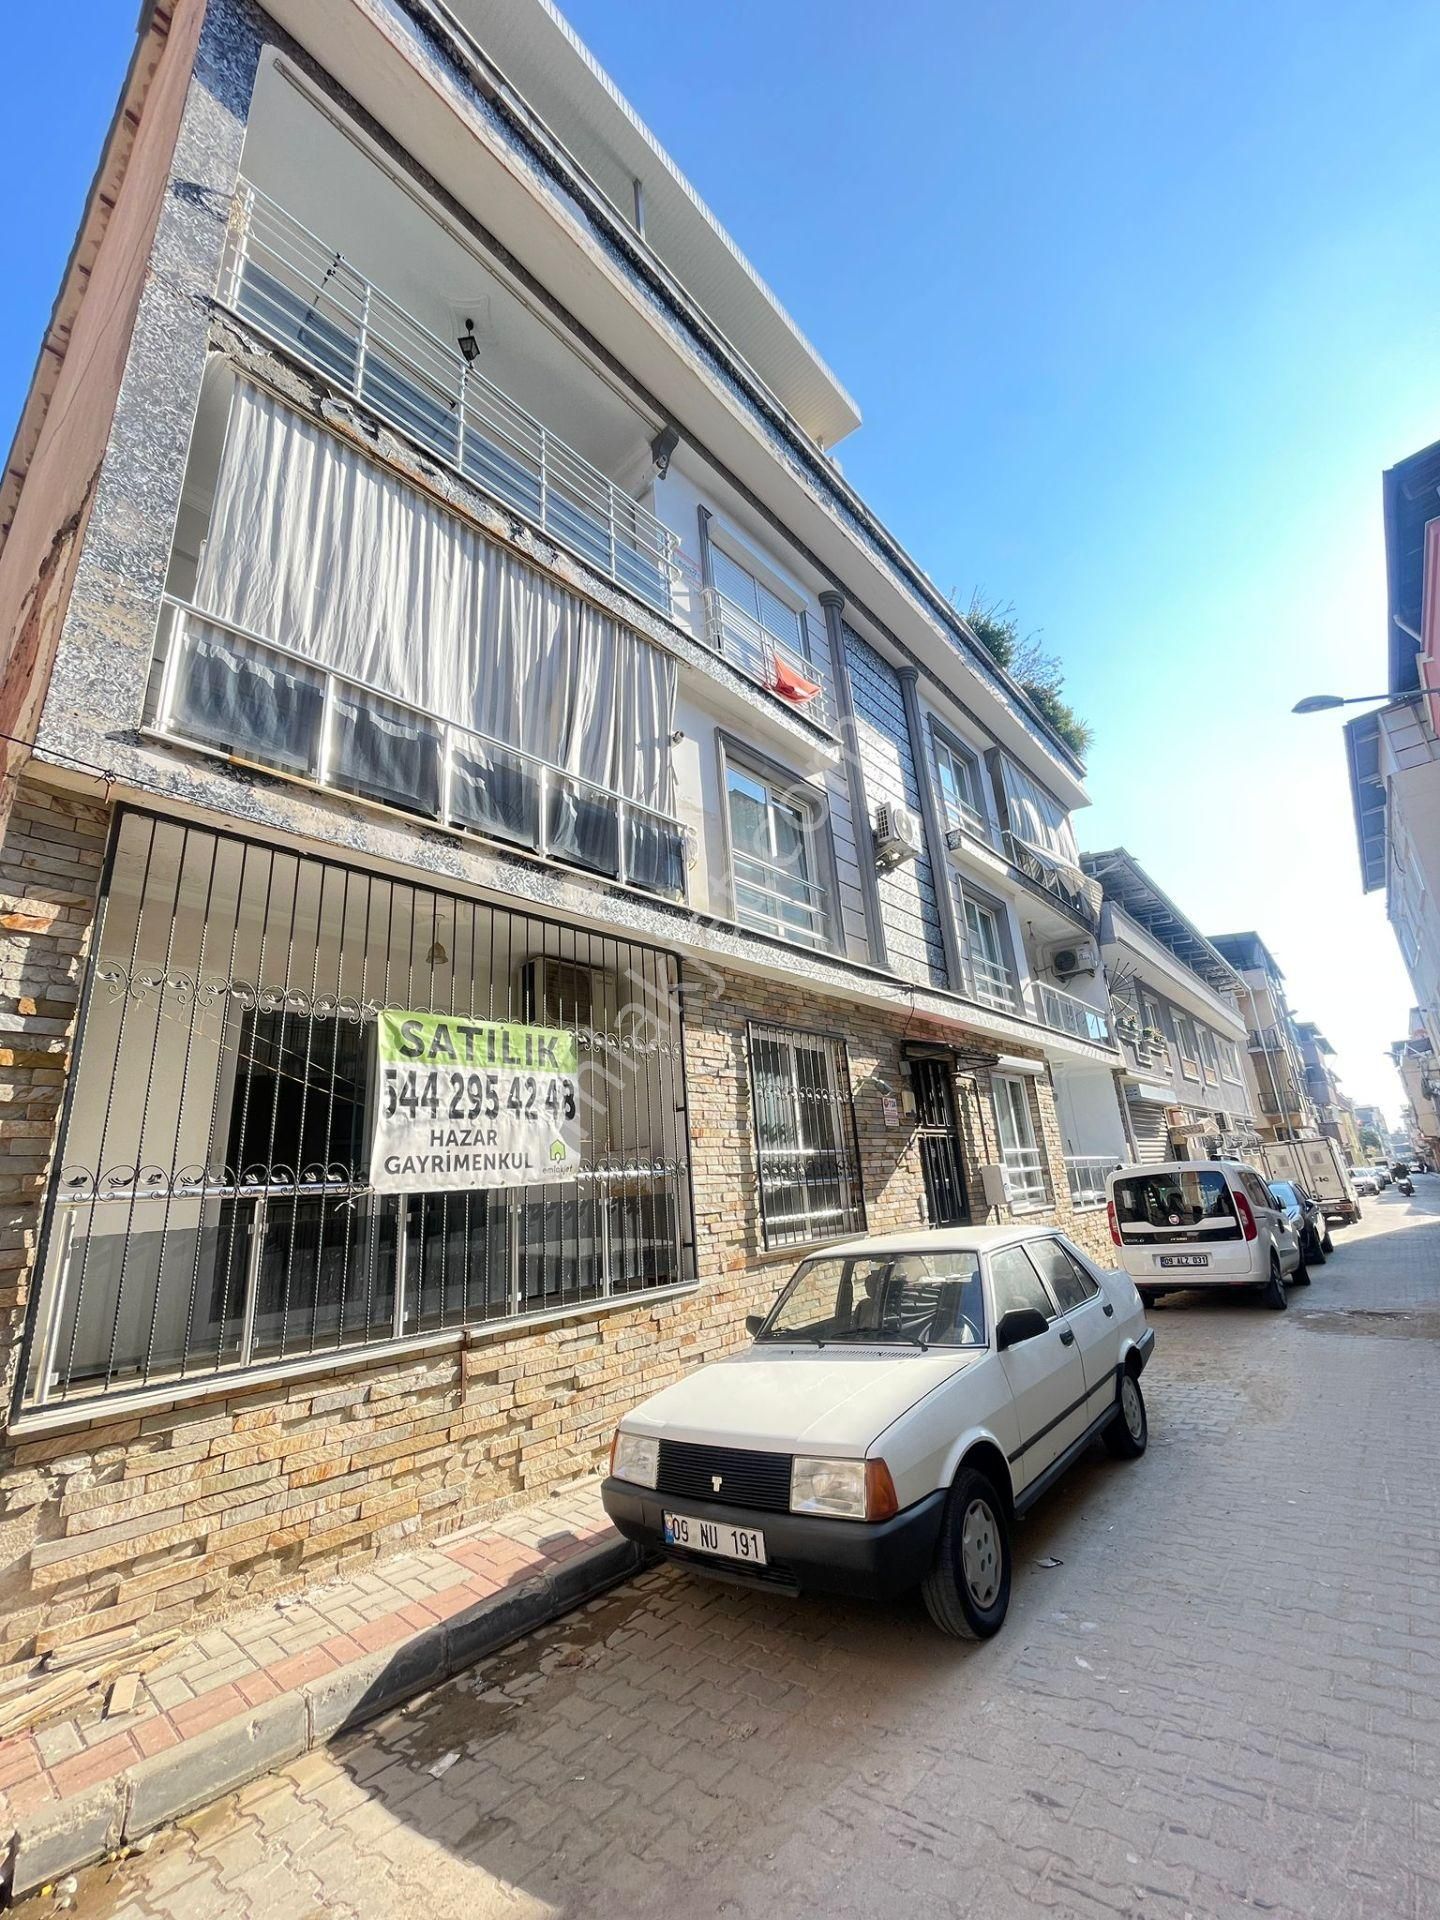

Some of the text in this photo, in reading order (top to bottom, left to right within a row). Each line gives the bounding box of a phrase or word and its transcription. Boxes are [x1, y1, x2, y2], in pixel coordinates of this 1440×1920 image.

[399, 1020, 559, 1068] SATILIK
[449, 1072, 499, 1121] 295
[506, 1077, 539, 1121] 42
[429, 1129, 499, 1148] HAZAR
[383, 1151, 534, 1175] GAYRİMENKUL
[1164, 1256, 1174, 1265] 09
[672, 1517, 759, 1559] 09 NU 191
